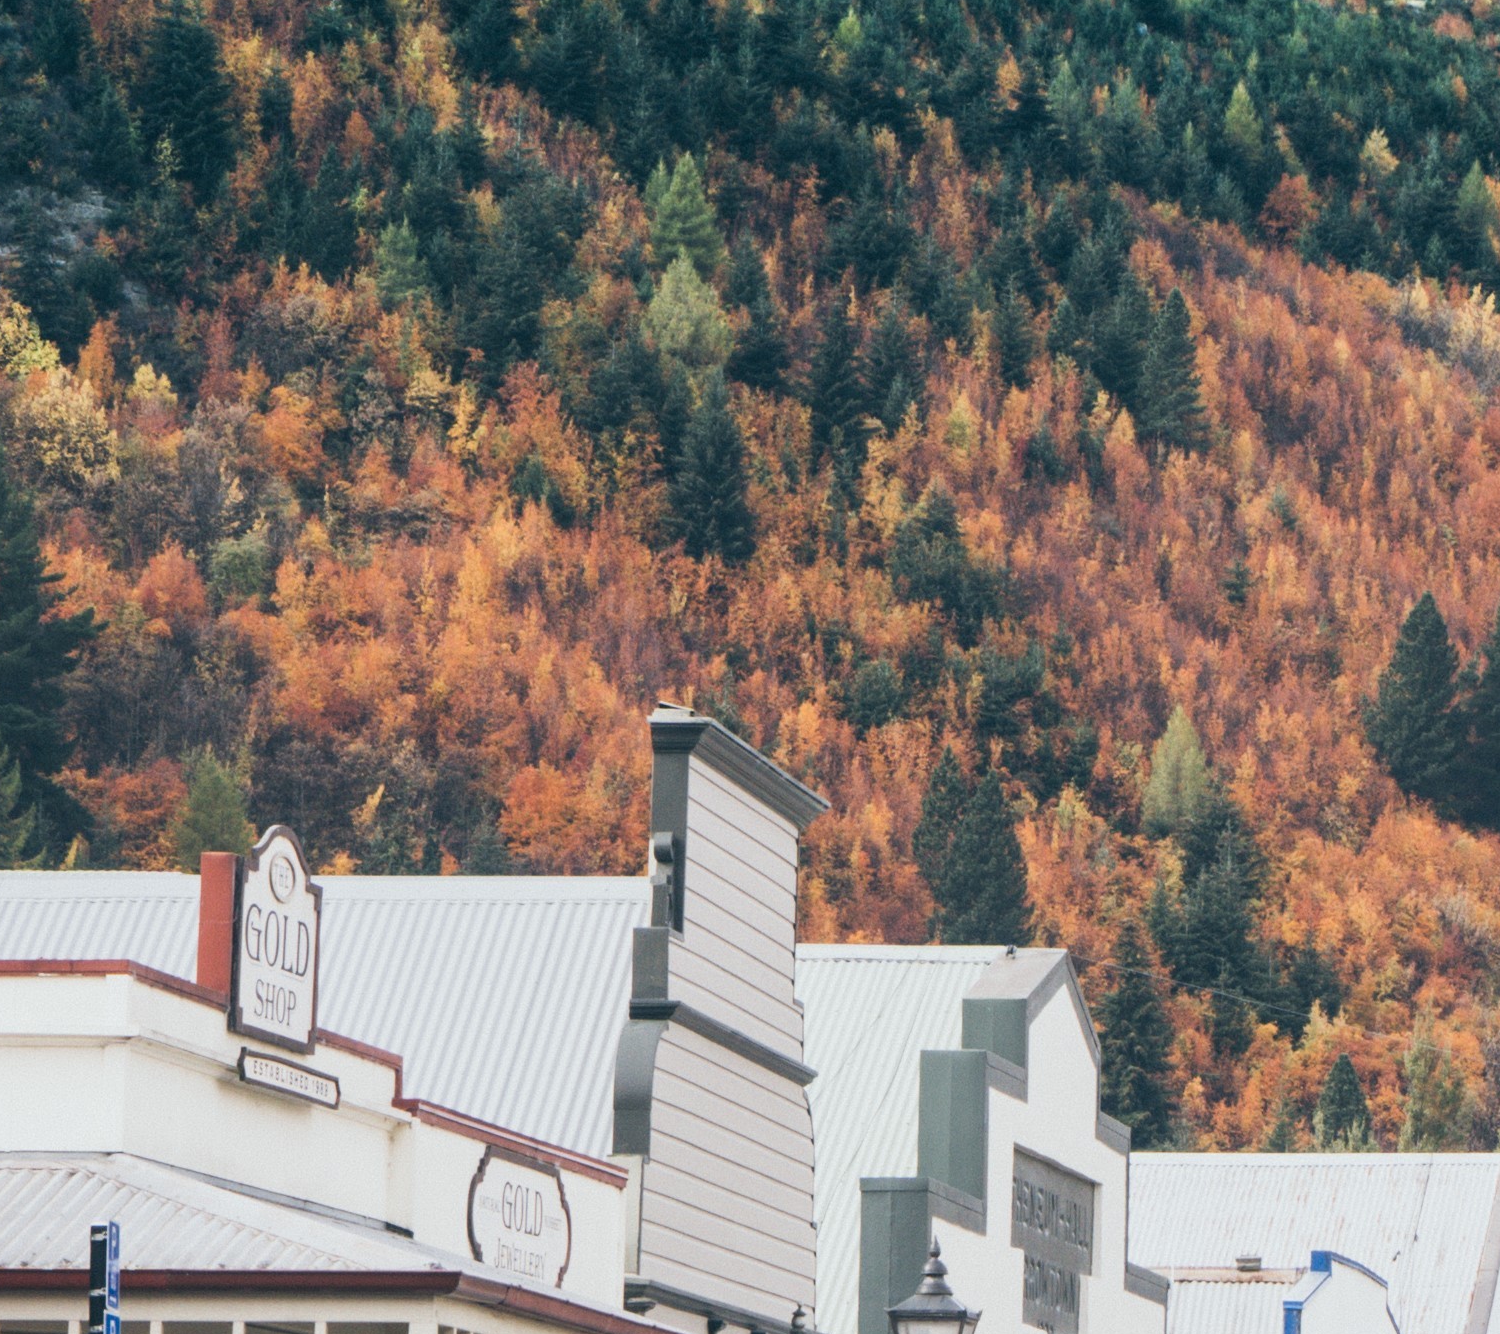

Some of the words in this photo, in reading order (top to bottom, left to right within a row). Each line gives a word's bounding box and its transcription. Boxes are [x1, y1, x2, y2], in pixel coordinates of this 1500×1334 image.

[274, 863, 290, 890] THE
[245, 903, 311, 978] GOLD
[253, 978, 297, 1027] SHOP
[252, 1060, 309, 1091] ESTABLISHED
[501, 1181, 543, 1237] GOLD
[494, 1238, 547, 1280] JEWELLERY
